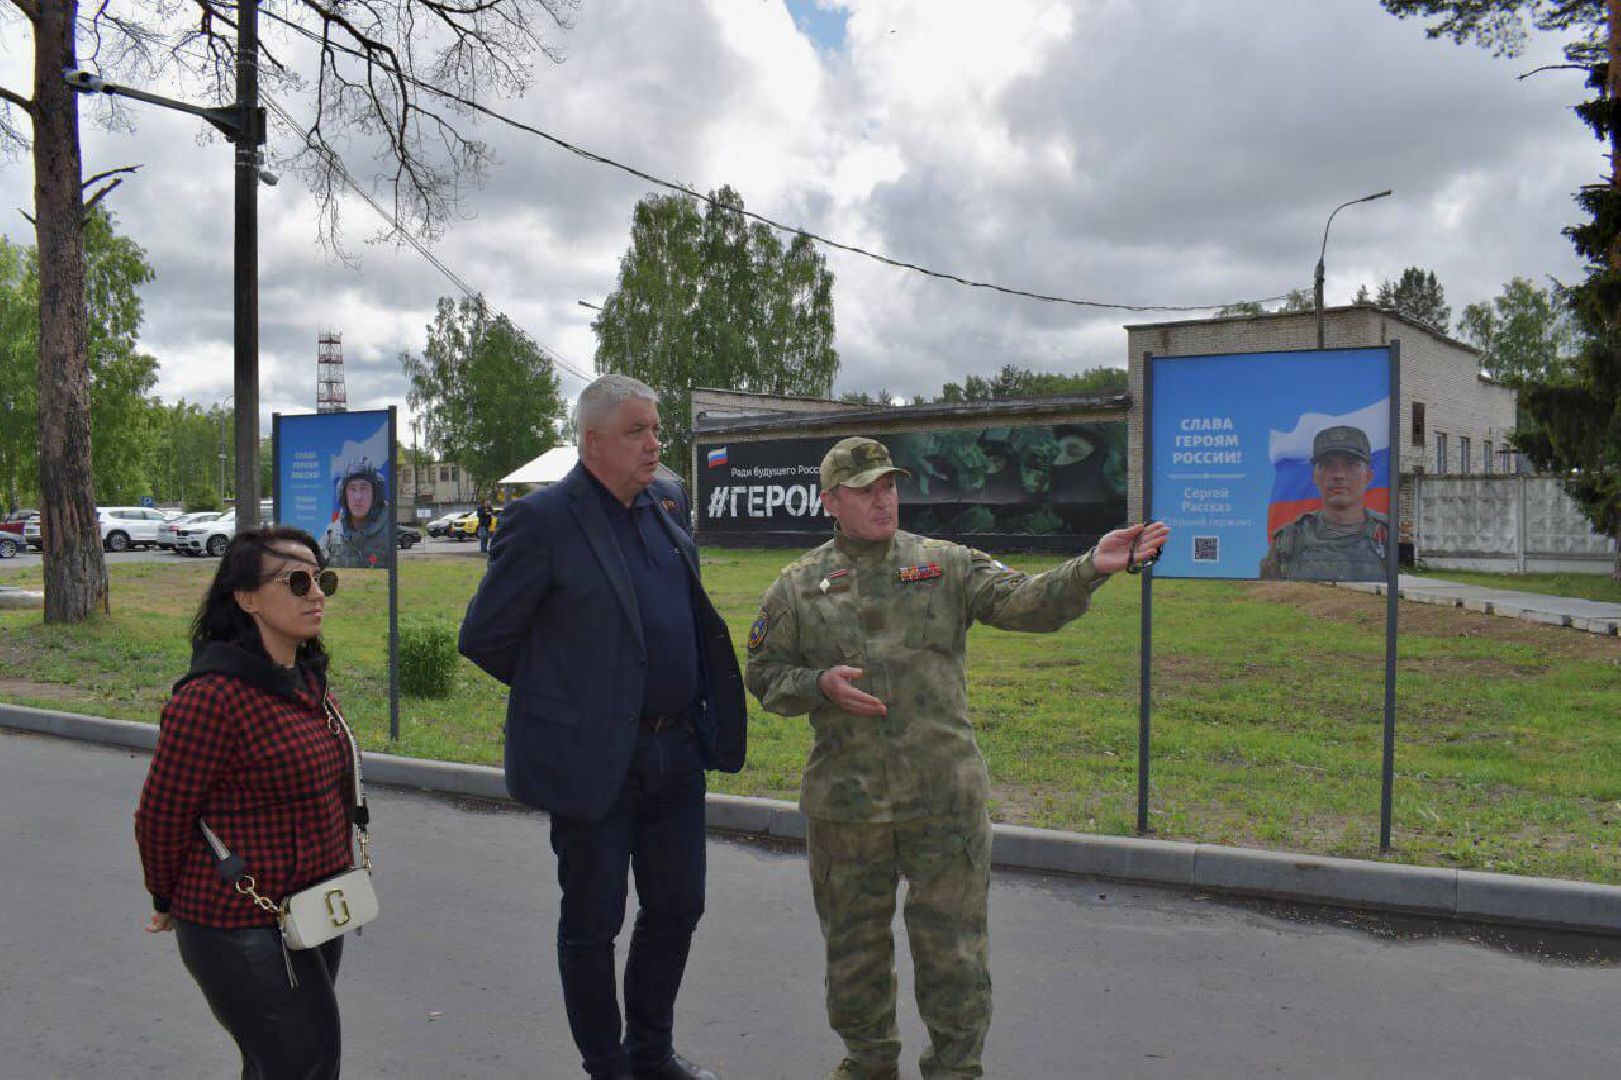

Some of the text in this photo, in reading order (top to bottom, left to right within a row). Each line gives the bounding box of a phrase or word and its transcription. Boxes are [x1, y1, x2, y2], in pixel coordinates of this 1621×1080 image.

[1180, 418, 1233, 431] СЛАВА
[1175, 434, 1239, 447] ГЕРОЯМ
[1172, 451, 1242, 464] РОССИИ!
